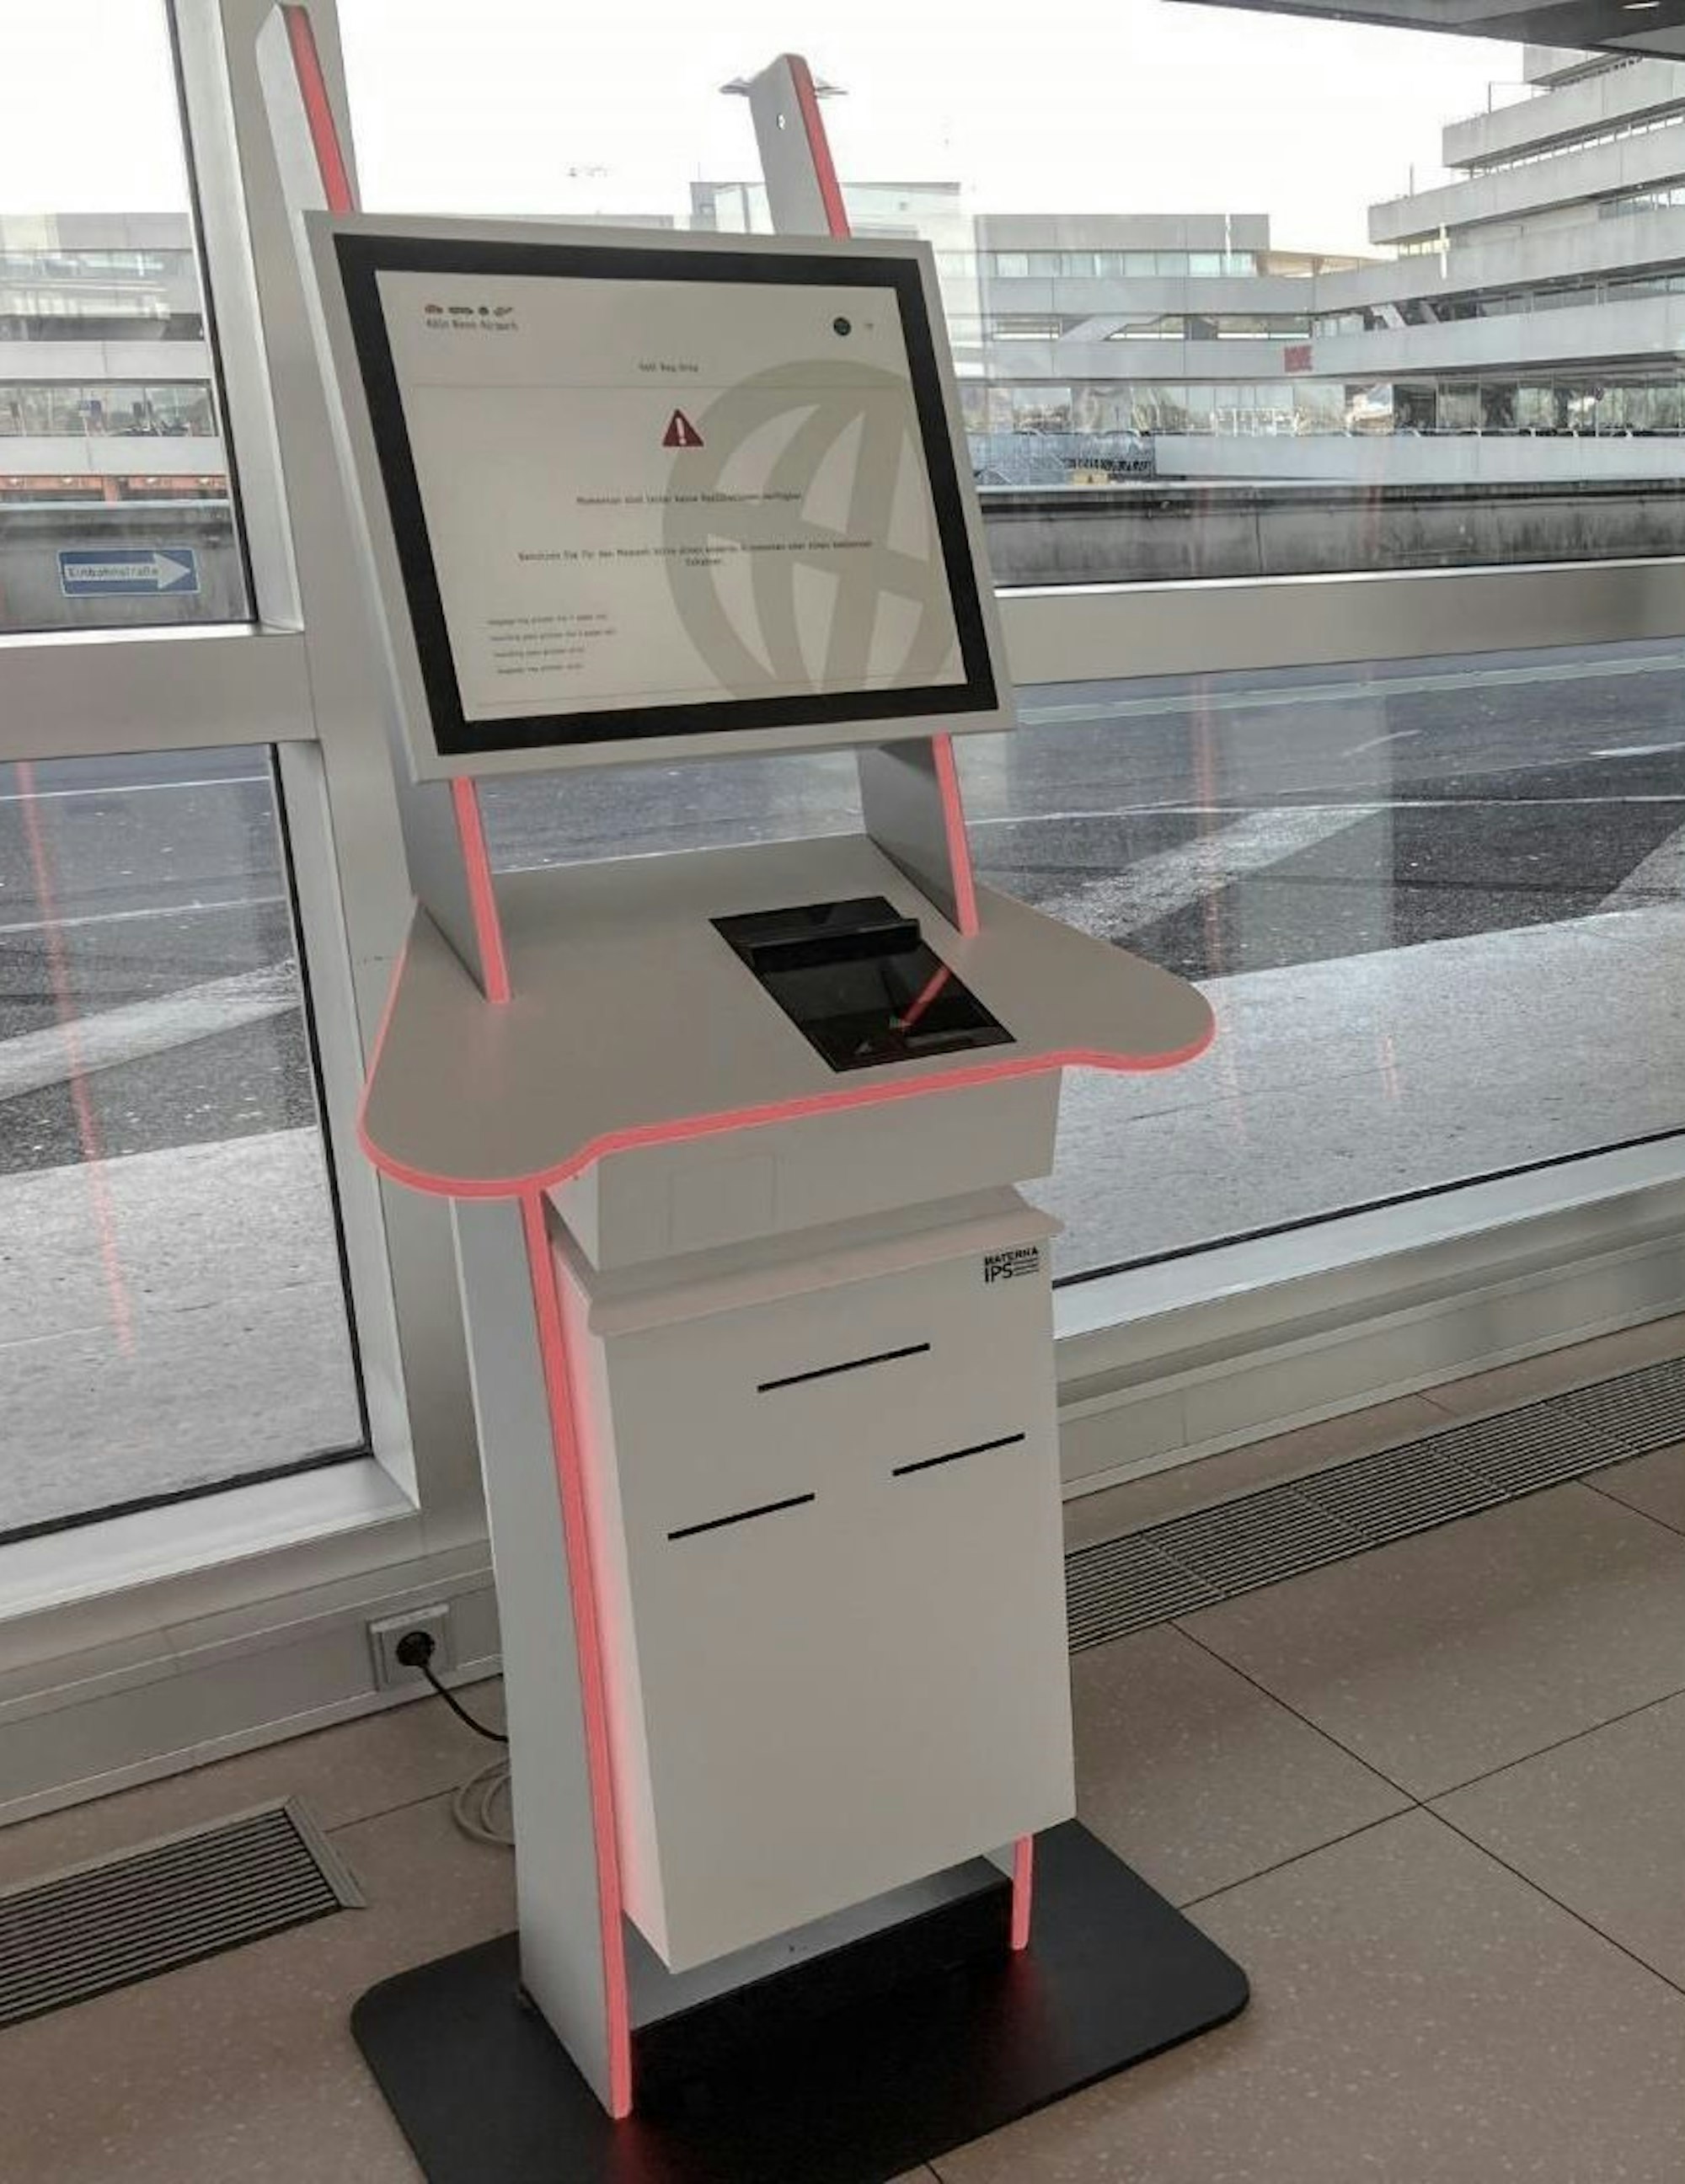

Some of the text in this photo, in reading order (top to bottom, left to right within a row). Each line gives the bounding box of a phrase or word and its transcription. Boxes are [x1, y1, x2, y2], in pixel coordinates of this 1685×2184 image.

[67, 567, 158, 578] Einbahnstraße
[985, 1247, 1039, 1265] MATERNA
[985, 1263, 1013, 1282] IPS
